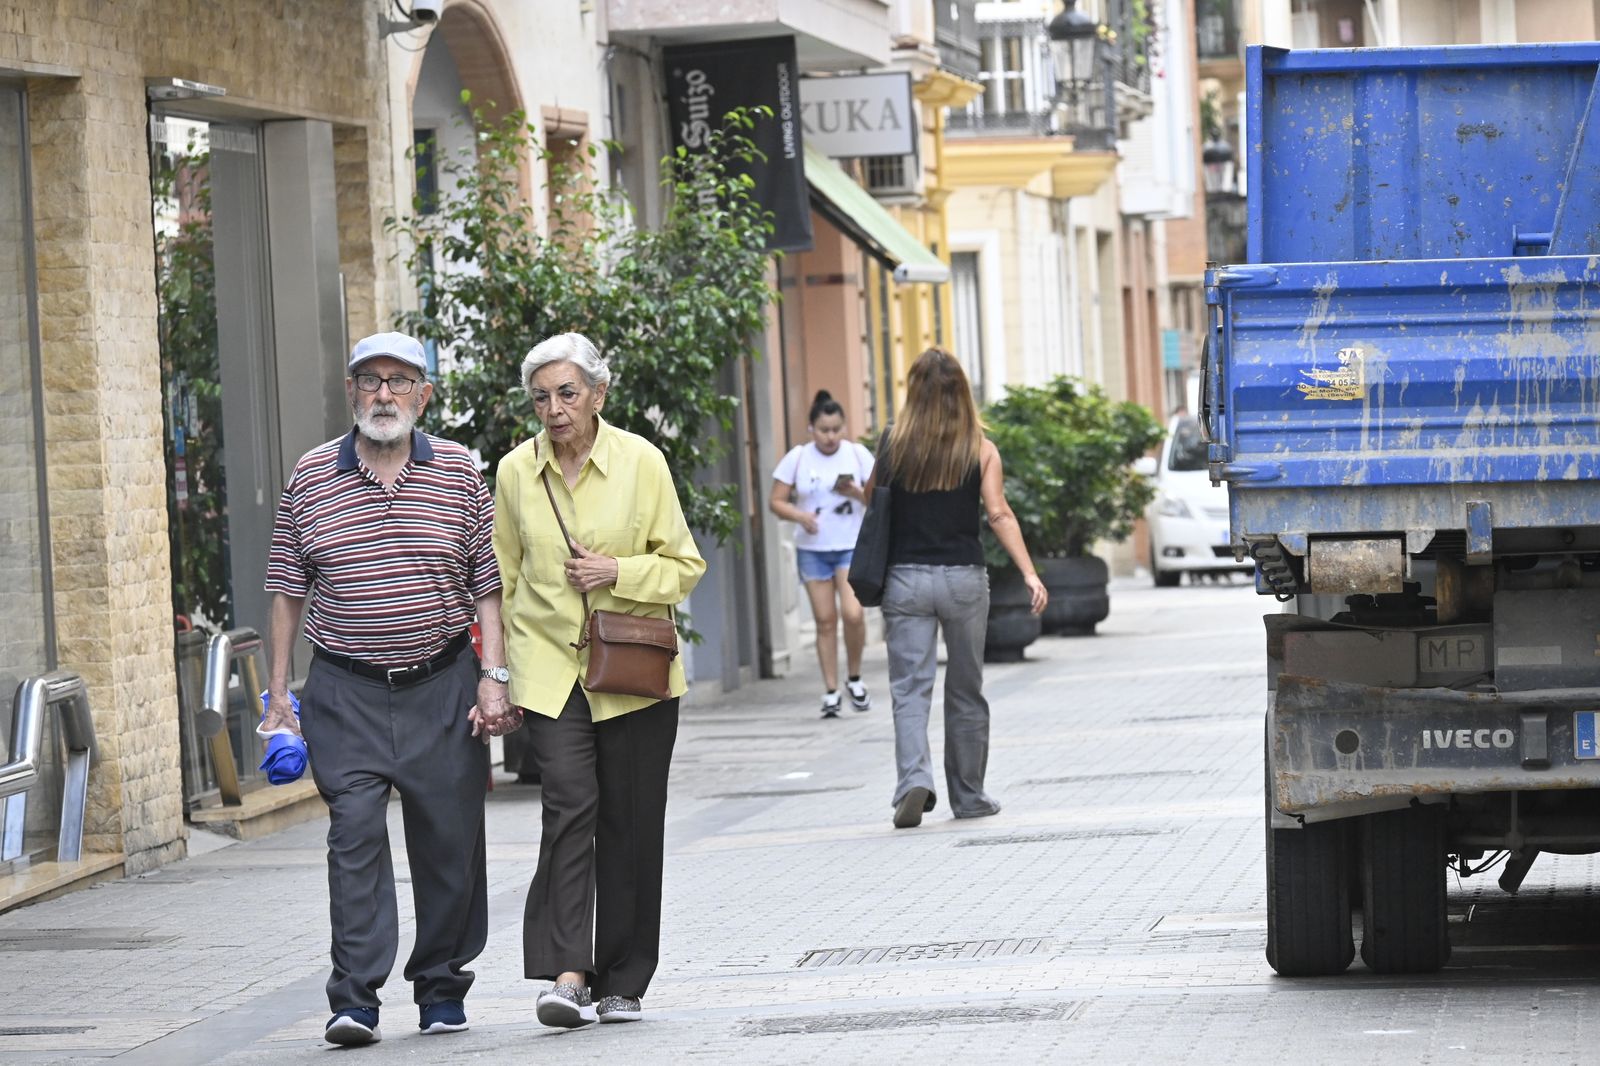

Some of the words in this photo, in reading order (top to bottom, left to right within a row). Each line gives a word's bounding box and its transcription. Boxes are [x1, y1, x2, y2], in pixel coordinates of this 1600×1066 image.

[777, 63, 793, 120] OUTDOOR
[782, 120, 796, 159] LIVING
[1422, 729, 1514, 749] IVECO
[1582, 739, 1591, 750] E
